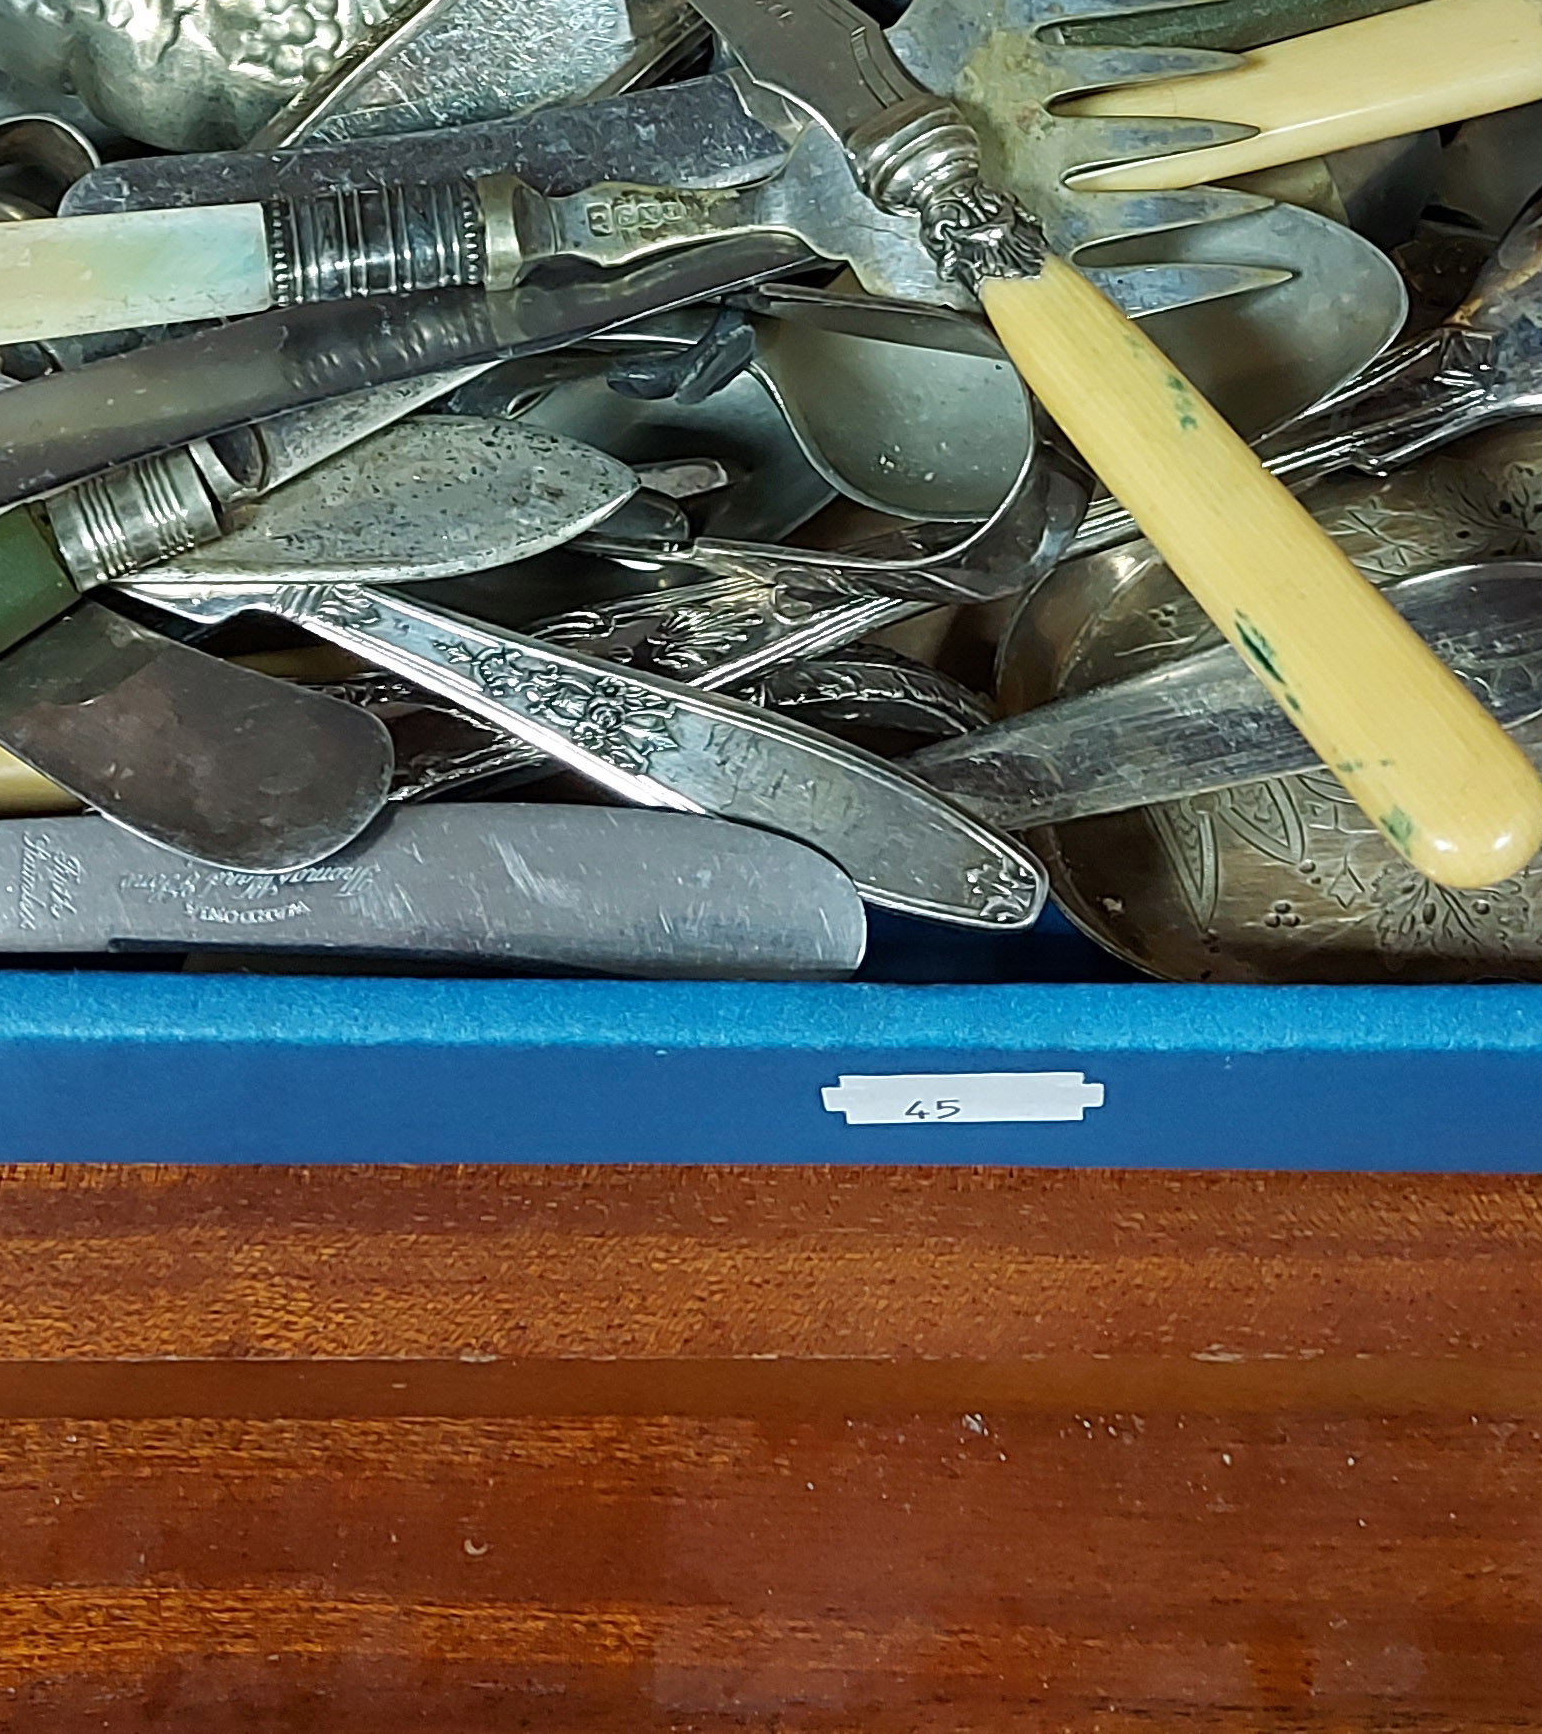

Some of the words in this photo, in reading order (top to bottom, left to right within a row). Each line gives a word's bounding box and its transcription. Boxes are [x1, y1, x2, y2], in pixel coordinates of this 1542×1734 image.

[203, 871, 278, 900] Ward
[280, 866, 380, 897] Thomas
[184, 900, 311, 924] WARDONIA
[905, 1099, 961, 1119] 45
